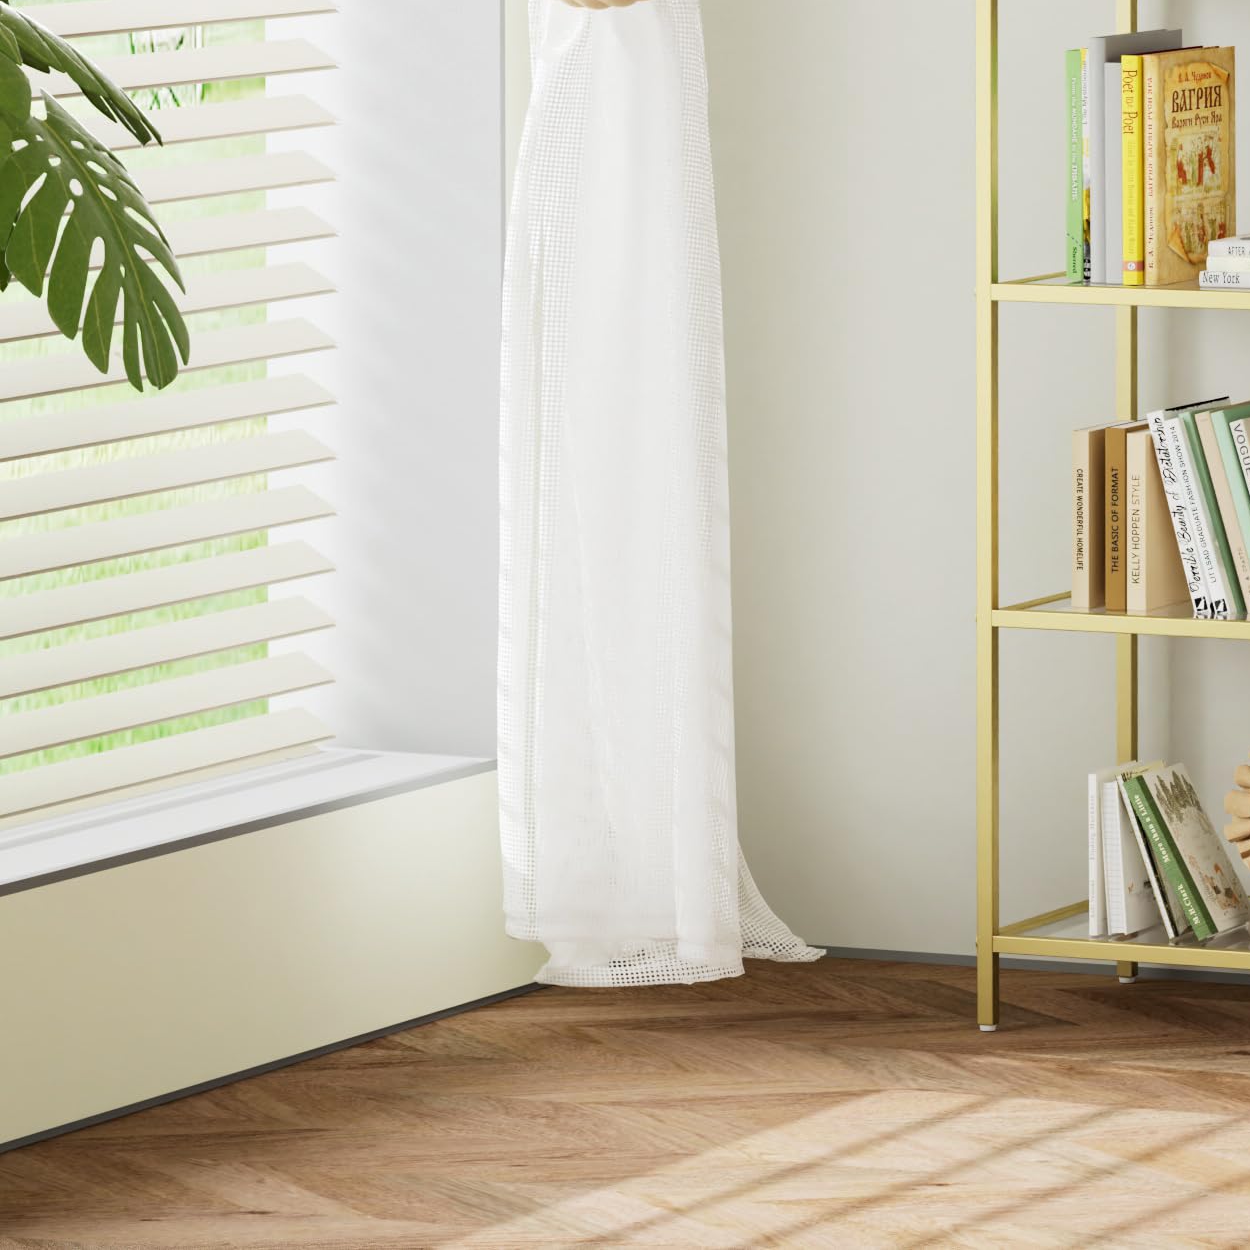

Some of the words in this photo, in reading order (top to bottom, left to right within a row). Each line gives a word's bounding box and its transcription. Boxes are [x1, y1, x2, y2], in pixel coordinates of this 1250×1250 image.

[1122, 69, 1138, 94] Poet
[1171, 85, 1223, 113] ВАГРИЯ
[1122, 111, 1139, 135] Poet
[1202, 272, 1220, 283] New
[1222, 272, 1240, 284] York
[1169, 426, 1179, 442] 2014
[1175, 444, 1186, 468] SHOW
[1076, 468, 1084, 494] CREATE
[1111, 468, 1119, 507] FORMAT
[1131, 474, 1140, 505] STYLE
[1182, 469, 1196, 505] FASHION
[1076, 495, 1084, 536] WONDERFUL
[1111, 510, 1119, 523] OF
[1192, 507, 1208, 548] GRADUATE
[1111, 525, 1119, 552] BASIC
[1131, 509, 1140, 550] HOPPEN
[1076, 537, 1084, 571] HOMELIFE
[1111, 556, 1119, 574] THE
[1131, 553, 1140, 584] KELLY
[1134, 794, 1148, 816] Little
[1158, 842, 1169, 863] More
